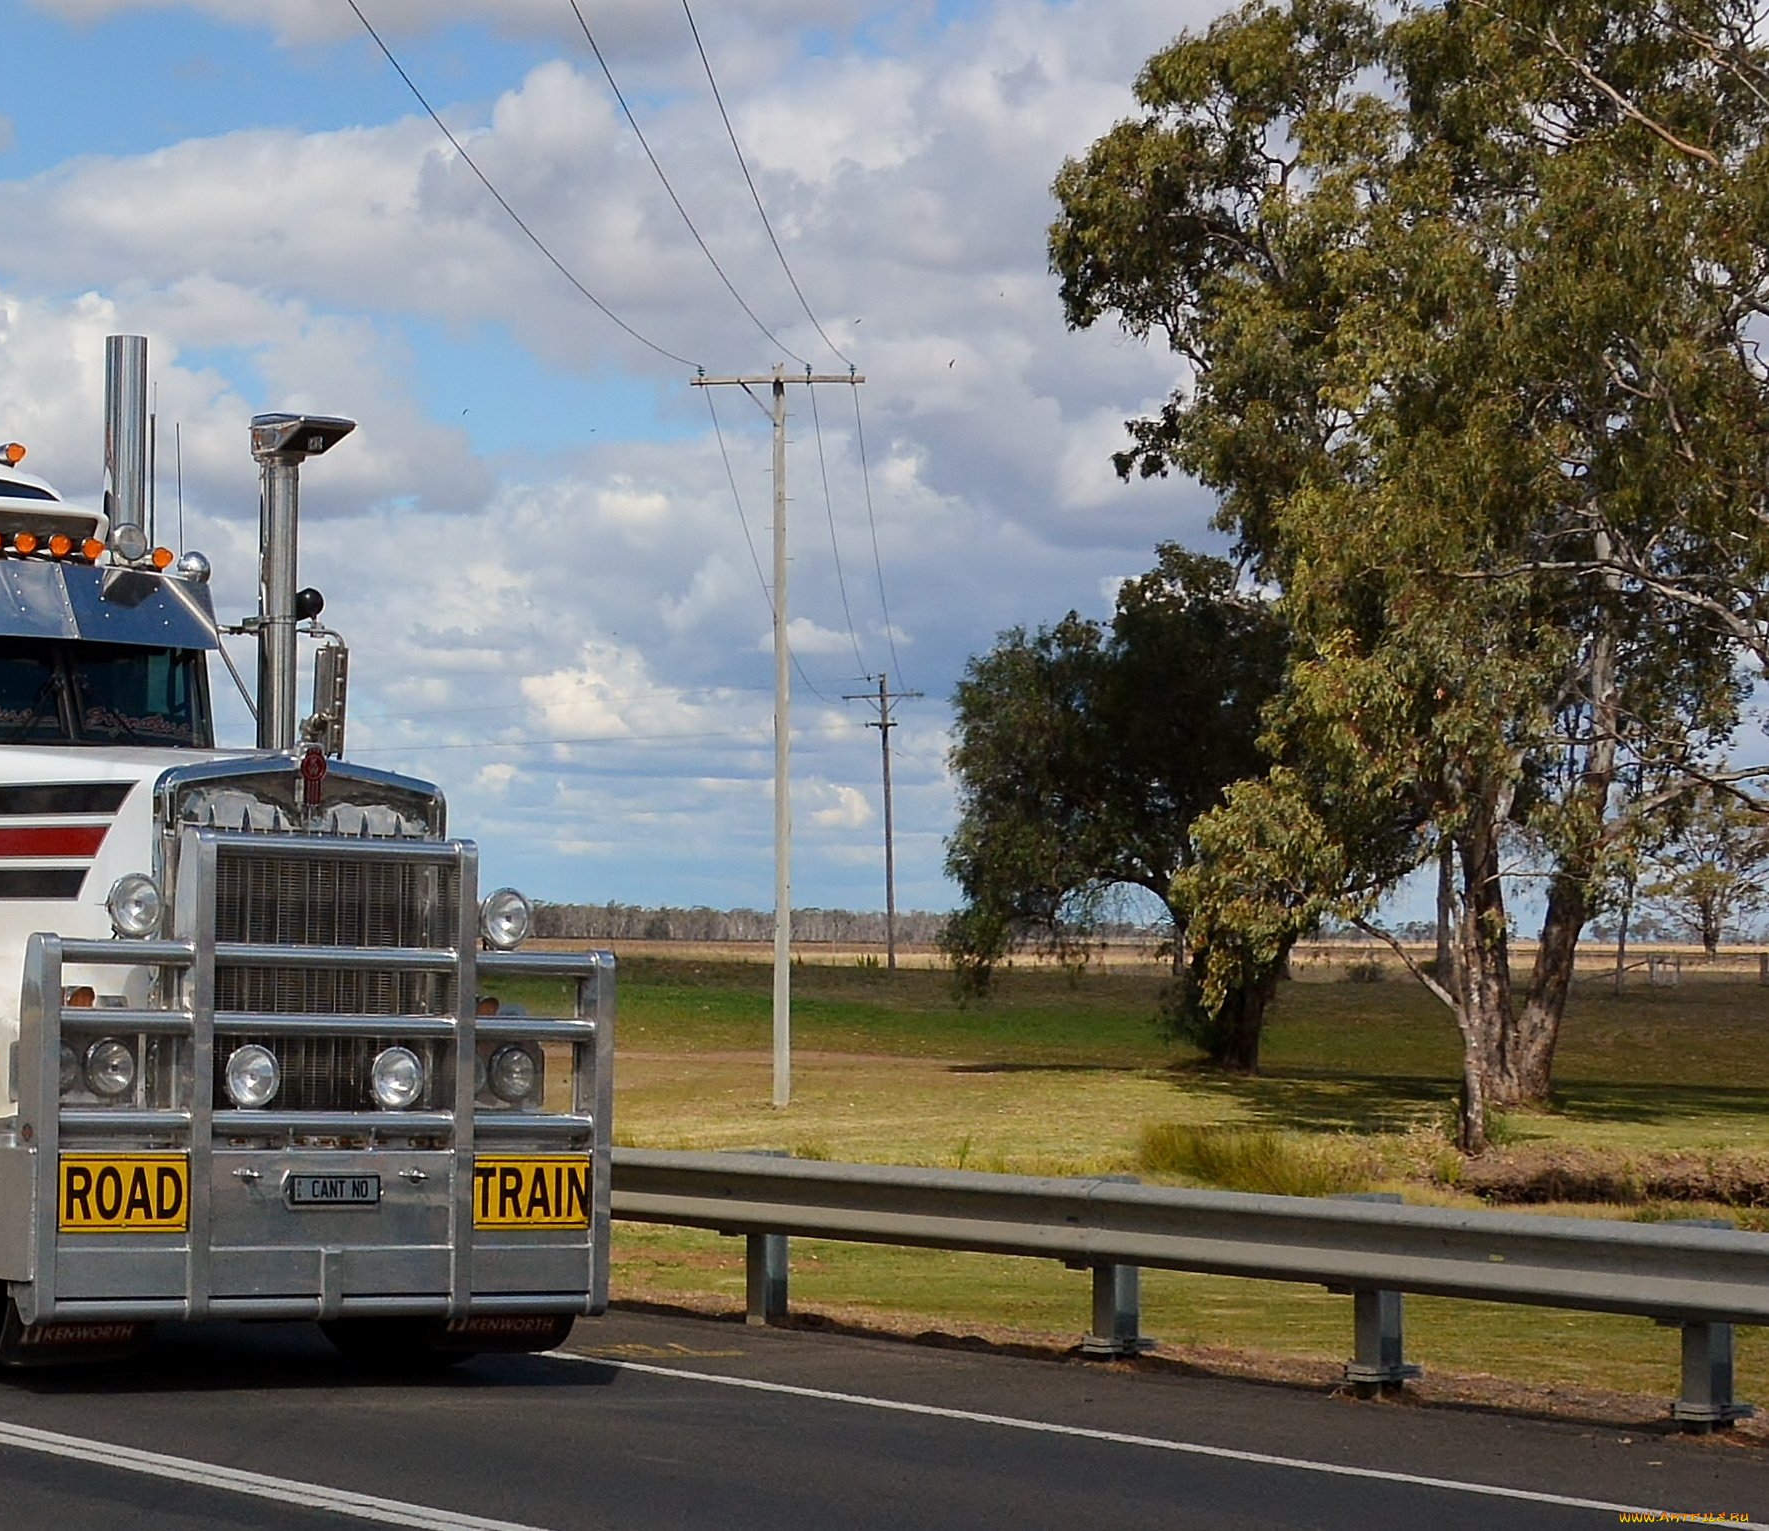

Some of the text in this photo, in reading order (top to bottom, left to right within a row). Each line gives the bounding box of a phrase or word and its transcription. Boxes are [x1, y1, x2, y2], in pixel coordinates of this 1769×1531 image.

[66, 1166, 182, 1220] ROAD
[312, 1180, 346, 1198] CANT
[352, 1180, 369, 1198] NO
[475, 1167, 590, 1218] TRAIN
[43, 1325, 133, 1340] KENWORTH
[469, 1319, 554, 1332] KENWORTH
